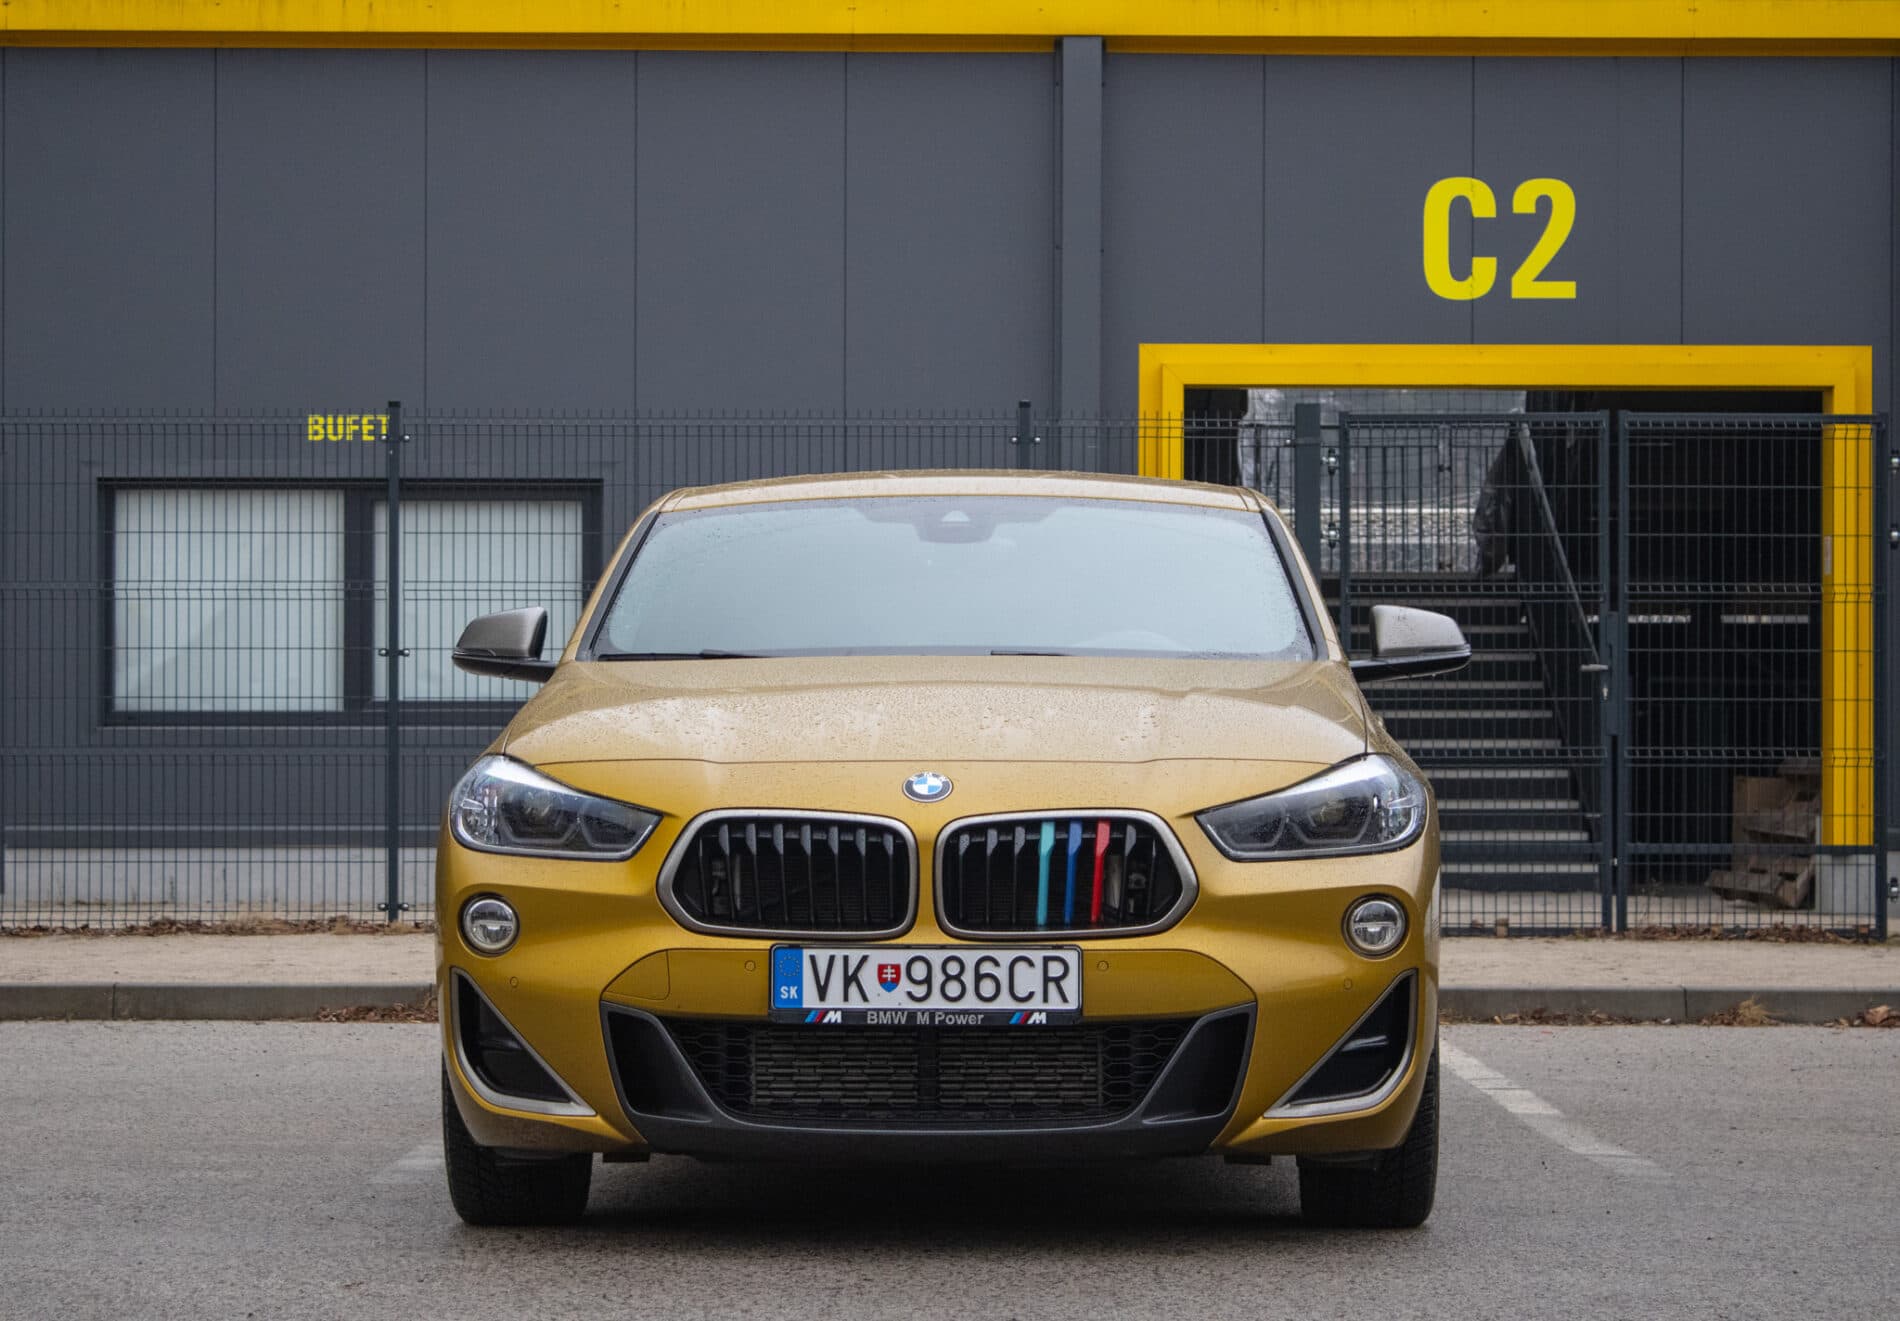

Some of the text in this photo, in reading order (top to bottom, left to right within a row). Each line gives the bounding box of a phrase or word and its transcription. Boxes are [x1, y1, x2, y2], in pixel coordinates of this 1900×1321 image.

[1423, 176, 1577, 300] C2
[307, 414, 389, 441] BUFET
[780, 985, 799, 999] SK
[808, 954, 1070, 1003] VK 986CR
[867, 1011, 985, 1025] BMW M Power
